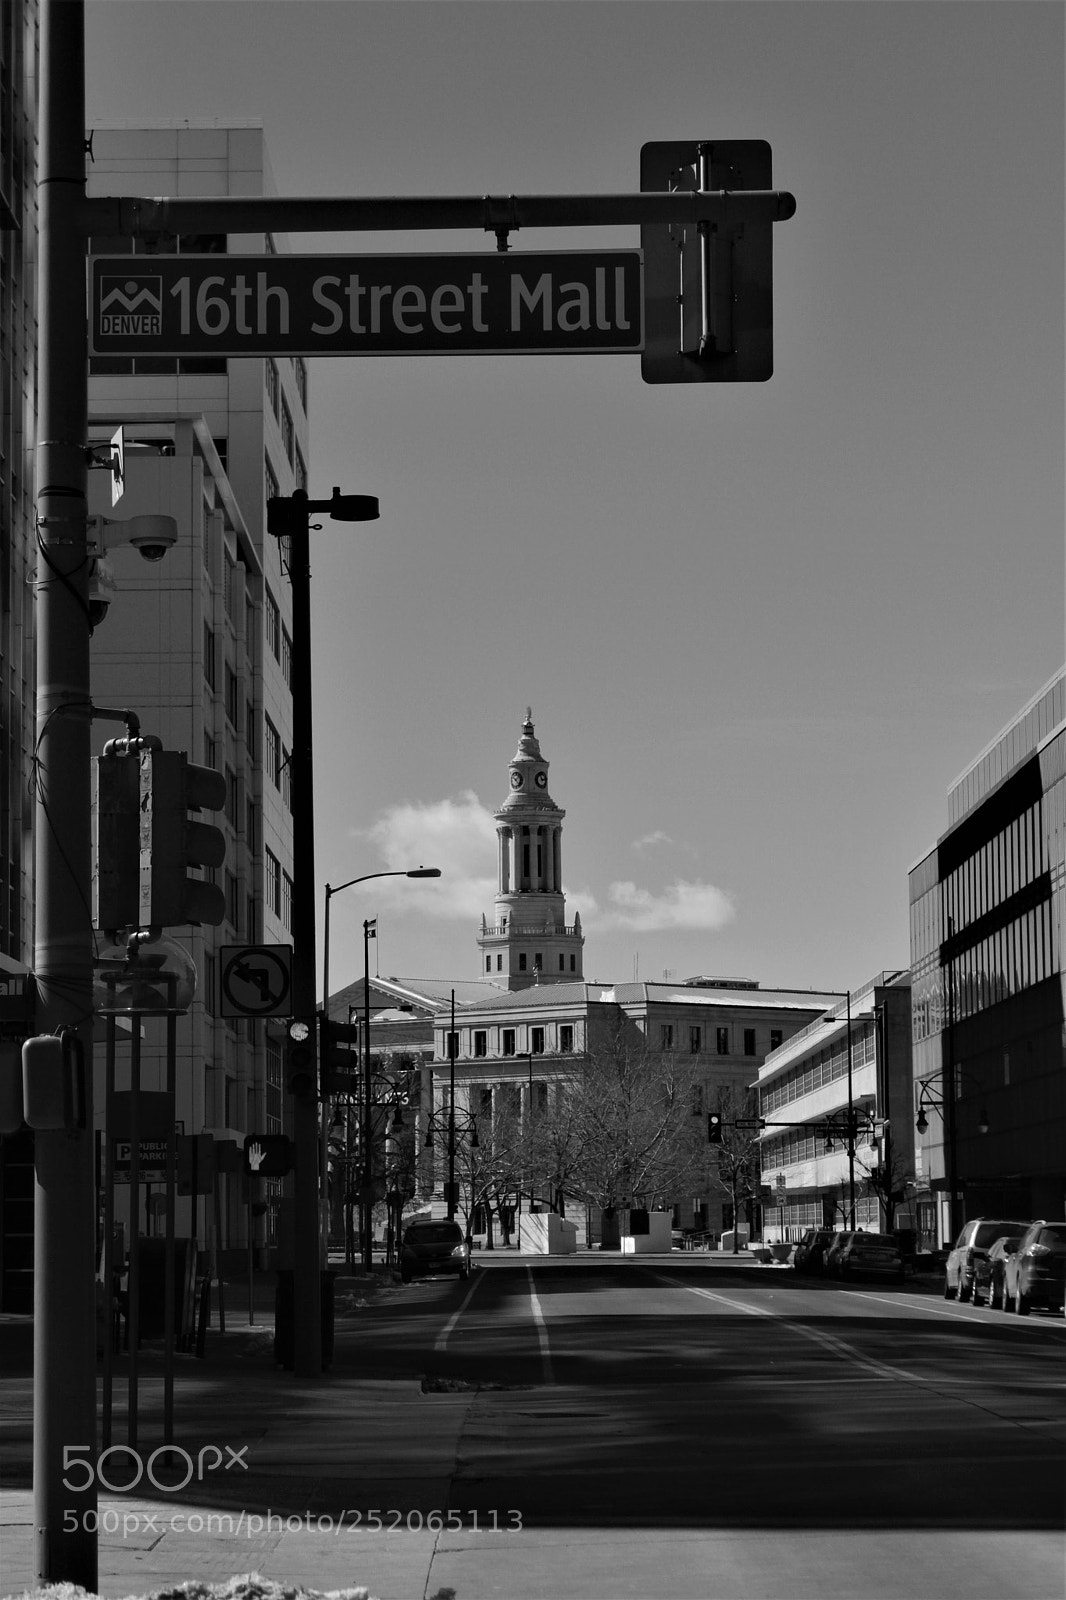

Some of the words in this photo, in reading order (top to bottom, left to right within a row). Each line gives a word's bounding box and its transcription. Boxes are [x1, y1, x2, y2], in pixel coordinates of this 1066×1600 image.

[170, 272, 289, 335] 16th
[311, 273, 488, 334] Street
[511, 267, 630, 331] Mall
[101, 316, 161, 334] DENVER
